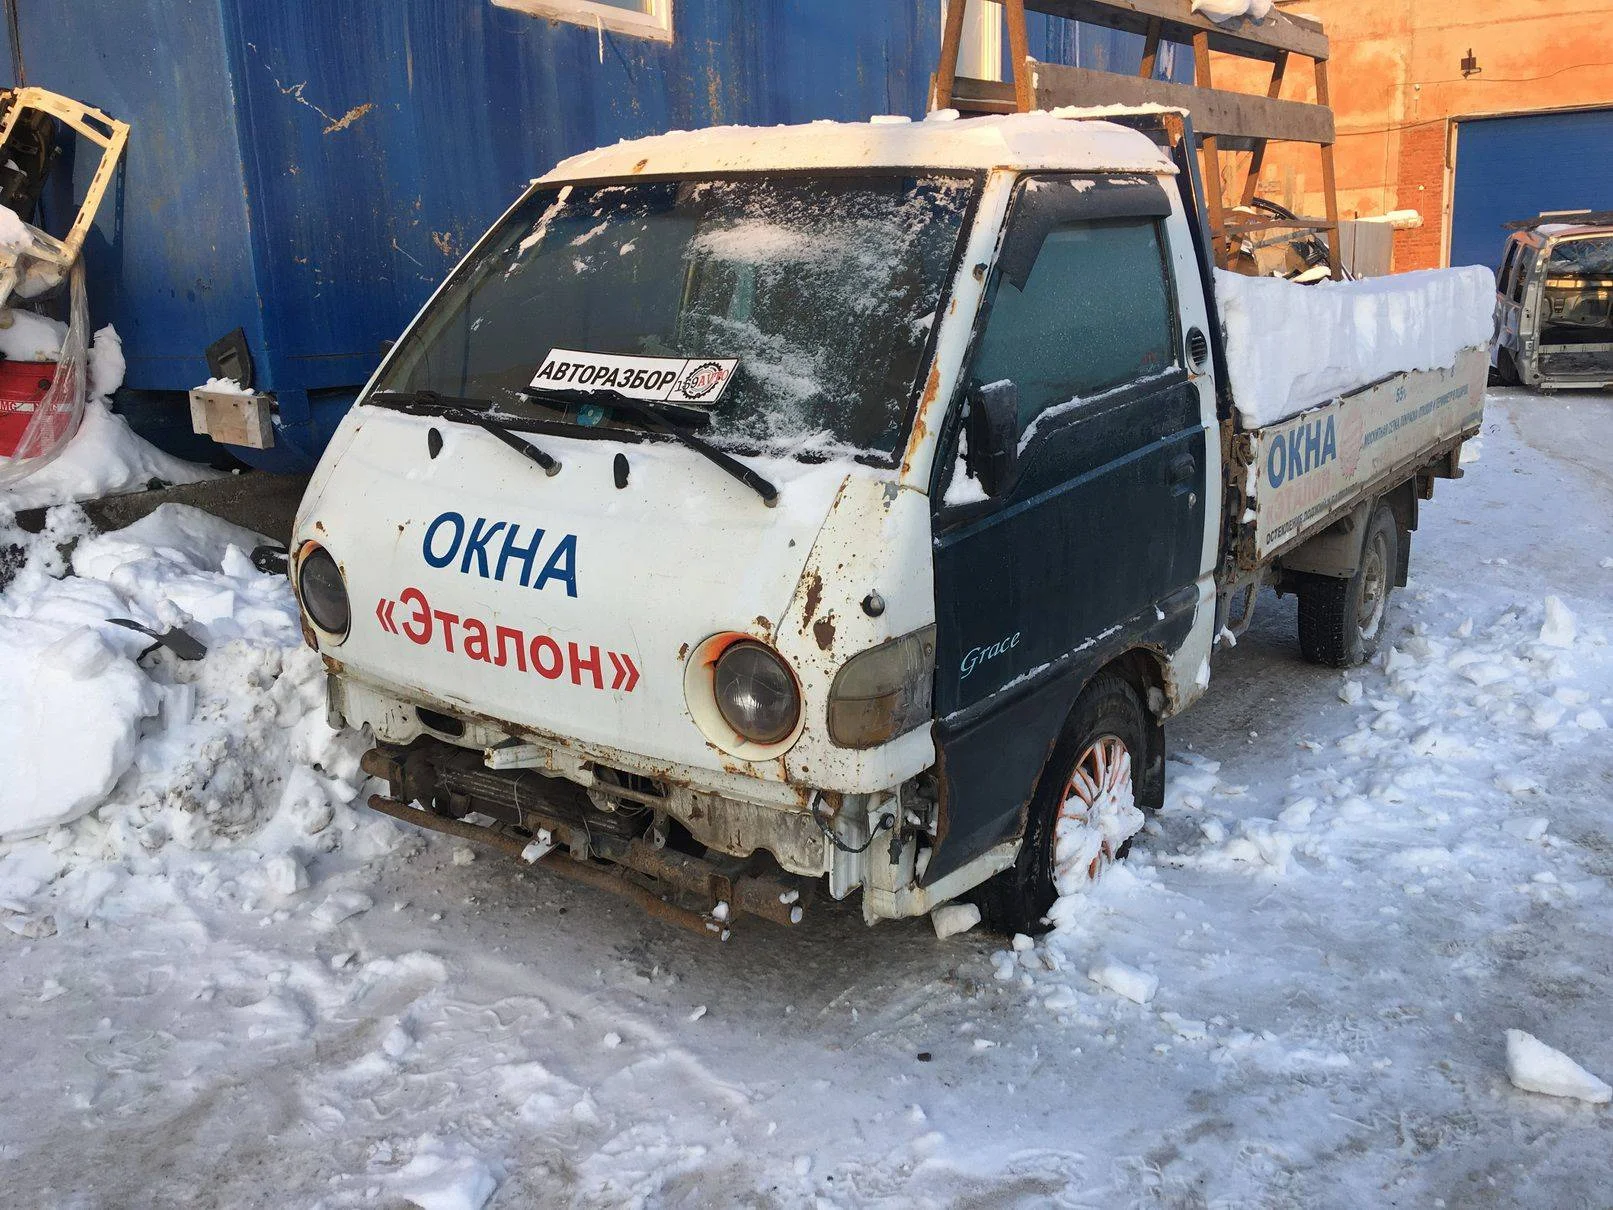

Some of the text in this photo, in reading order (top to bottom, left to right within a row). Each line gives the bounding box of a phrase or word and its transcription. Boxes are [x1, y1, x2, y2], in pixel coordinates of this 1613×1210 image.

[539, 361, 677, 392] АВТОРАЗБОР
[1267, 414, 1336, 489] ОКНА
[422, 511, 578, 598] ОКНА
[375, 587, 641, 693] «Эталон»
[960, 632, 1020, 680] Grace
